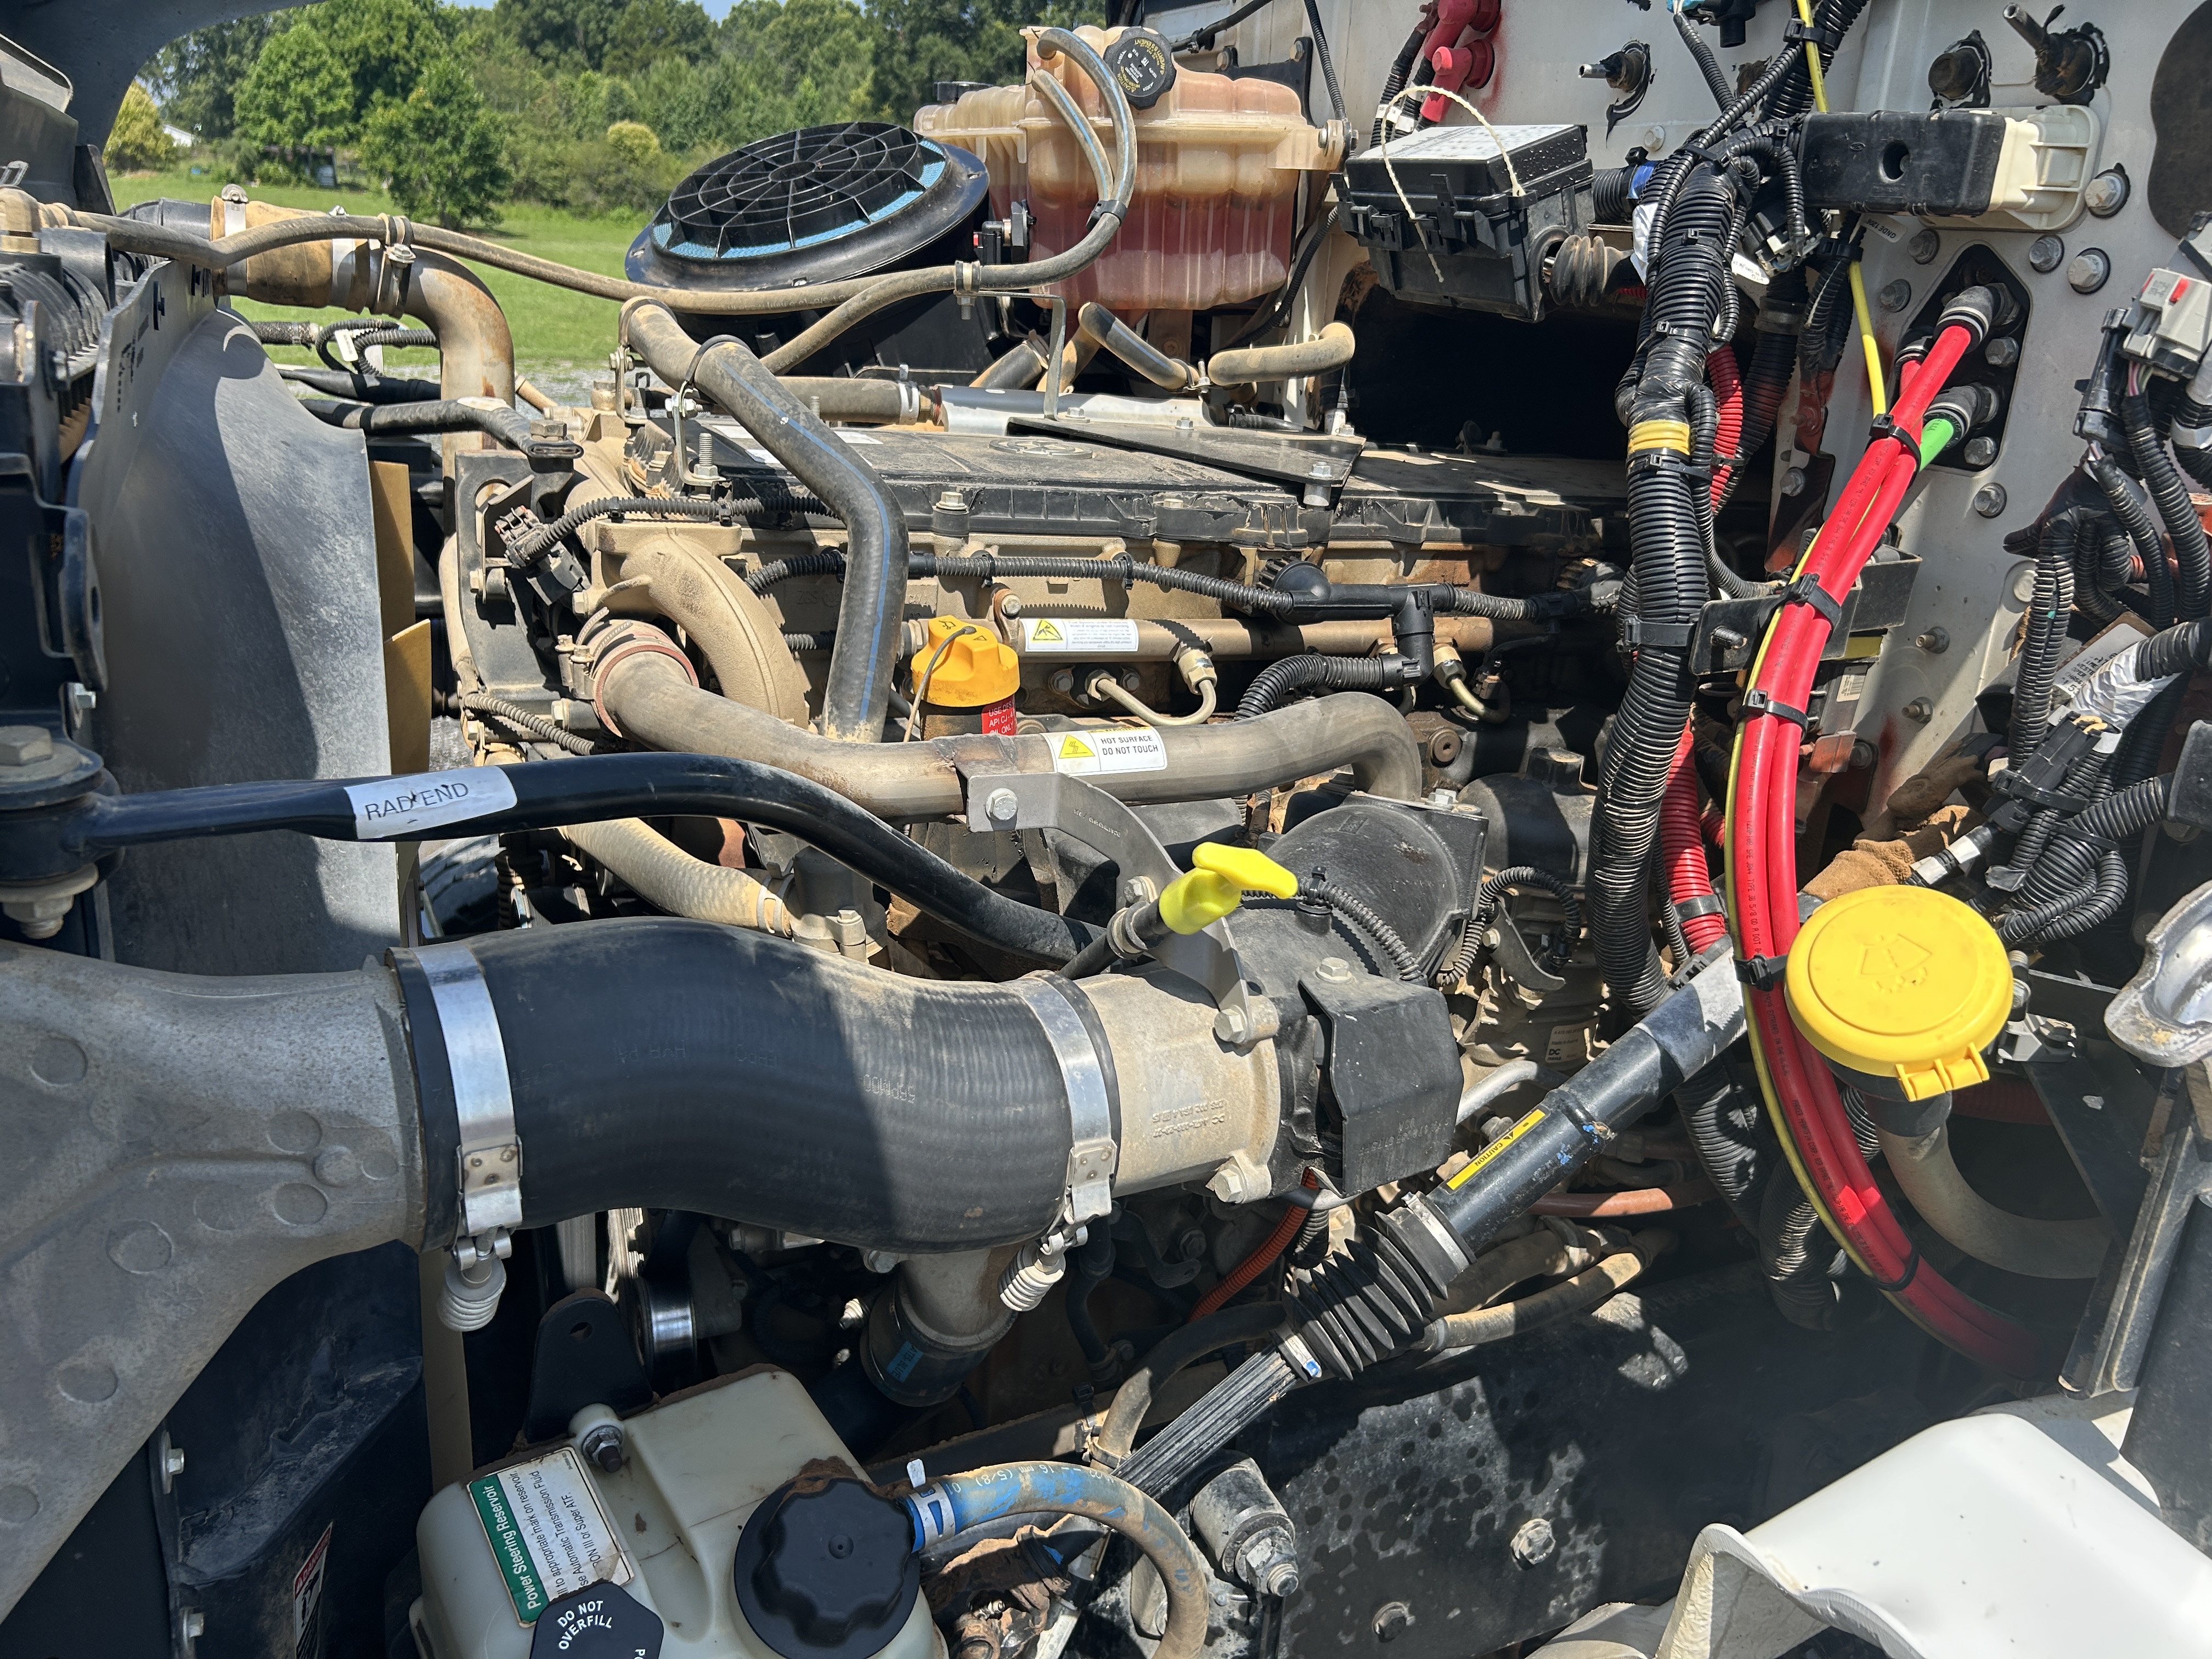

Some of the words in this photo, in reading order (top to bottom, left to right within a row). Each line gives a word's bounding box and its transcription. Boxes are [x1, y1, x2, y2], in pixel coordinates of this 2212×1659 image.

[1878, 225, 1896, 238] GNDE
[989, 706, 1002, 717] USE
[989, 717, 1000, 728] API
[1001, 720, 1013, 734] ONLY
[1119, 735, 1153, 743] SURFACE
[1115, 746, 1130, 754] NOT
[1133, 744, 1159, 753] TOUCH
[365, 795, 413, 821] RAD
[420, 782, 469, 806] END
[1752, 933, 1760, 945] DOT
[1765, 1009, 1780, 1036] EXTRUDED
[1775, 1046, 1785, 1056] THE
[1790, 1098, 1805, 1118] PARKER
[1474, 1143, 1503, 1166] CAUTION
[1814, 1156, 1824, 1167] AIR
[1818, 1165, 1831, 1183] BRAKE
[891, 1359, 909, 1379] BLUE
[975, 1469, 1014, 1487] (5/8)
[1018, 1465, 1036, 1474] mm
[508, 1469, 529, 1504] reservoir.
[529, 1470, 544, 1489] Fluid
[945, 1481, 962, 1493] 01
[481, 1483, 509, 1531] Reservoir
[523, 1503, 534, 1514] on
[561, 1492, 575, 1509] ATF.
[539, 1487, 566, 1538] Transmission
[570, 1506, 588, 1531] Super
[526, 1514, 542, 1535] mark
[580, 1530, 590, 1539] or
[583, 1539, 594, 1548] III
[500, 1529, 529, 1575] Steering
[535, 1532, 562, 1578] appropriate
[560, 1535, 583, 1576] Automatic
[554, 1577, 565, 1587] to
[517, 1573, 541, 1610] Power
[557, 1610, 575, 1628] DO
[578, 1600, 603, 1615] NOT
[558, 1615, 612, 1650] OVERFILL
